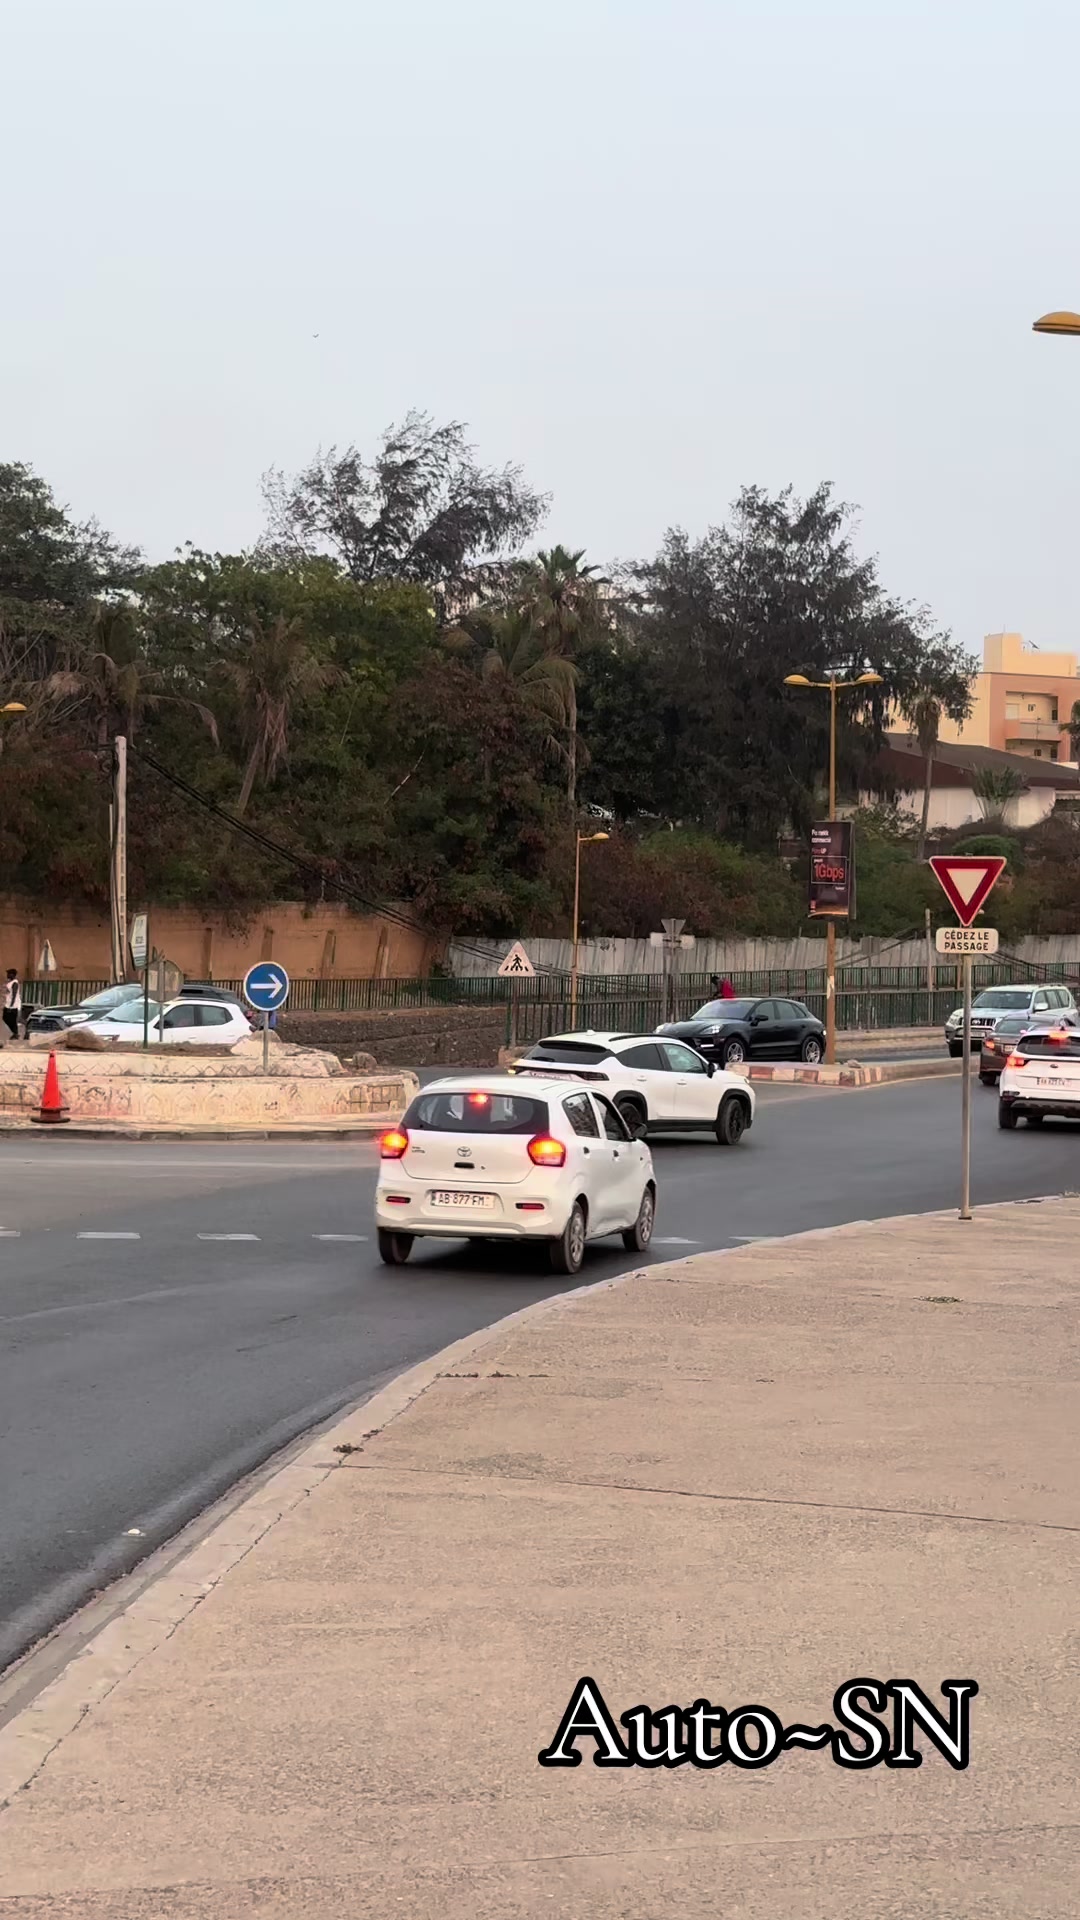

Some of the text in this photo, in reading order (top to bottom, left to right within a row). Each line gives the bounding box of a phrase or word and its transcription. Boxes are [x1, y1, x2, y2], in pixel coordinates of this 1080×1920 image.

[814, 863, 845, 881] 1Gbps
[944, 930, 989, 940] CÉDEZ LE
[944, 941, 989, 951] PASSAGE
